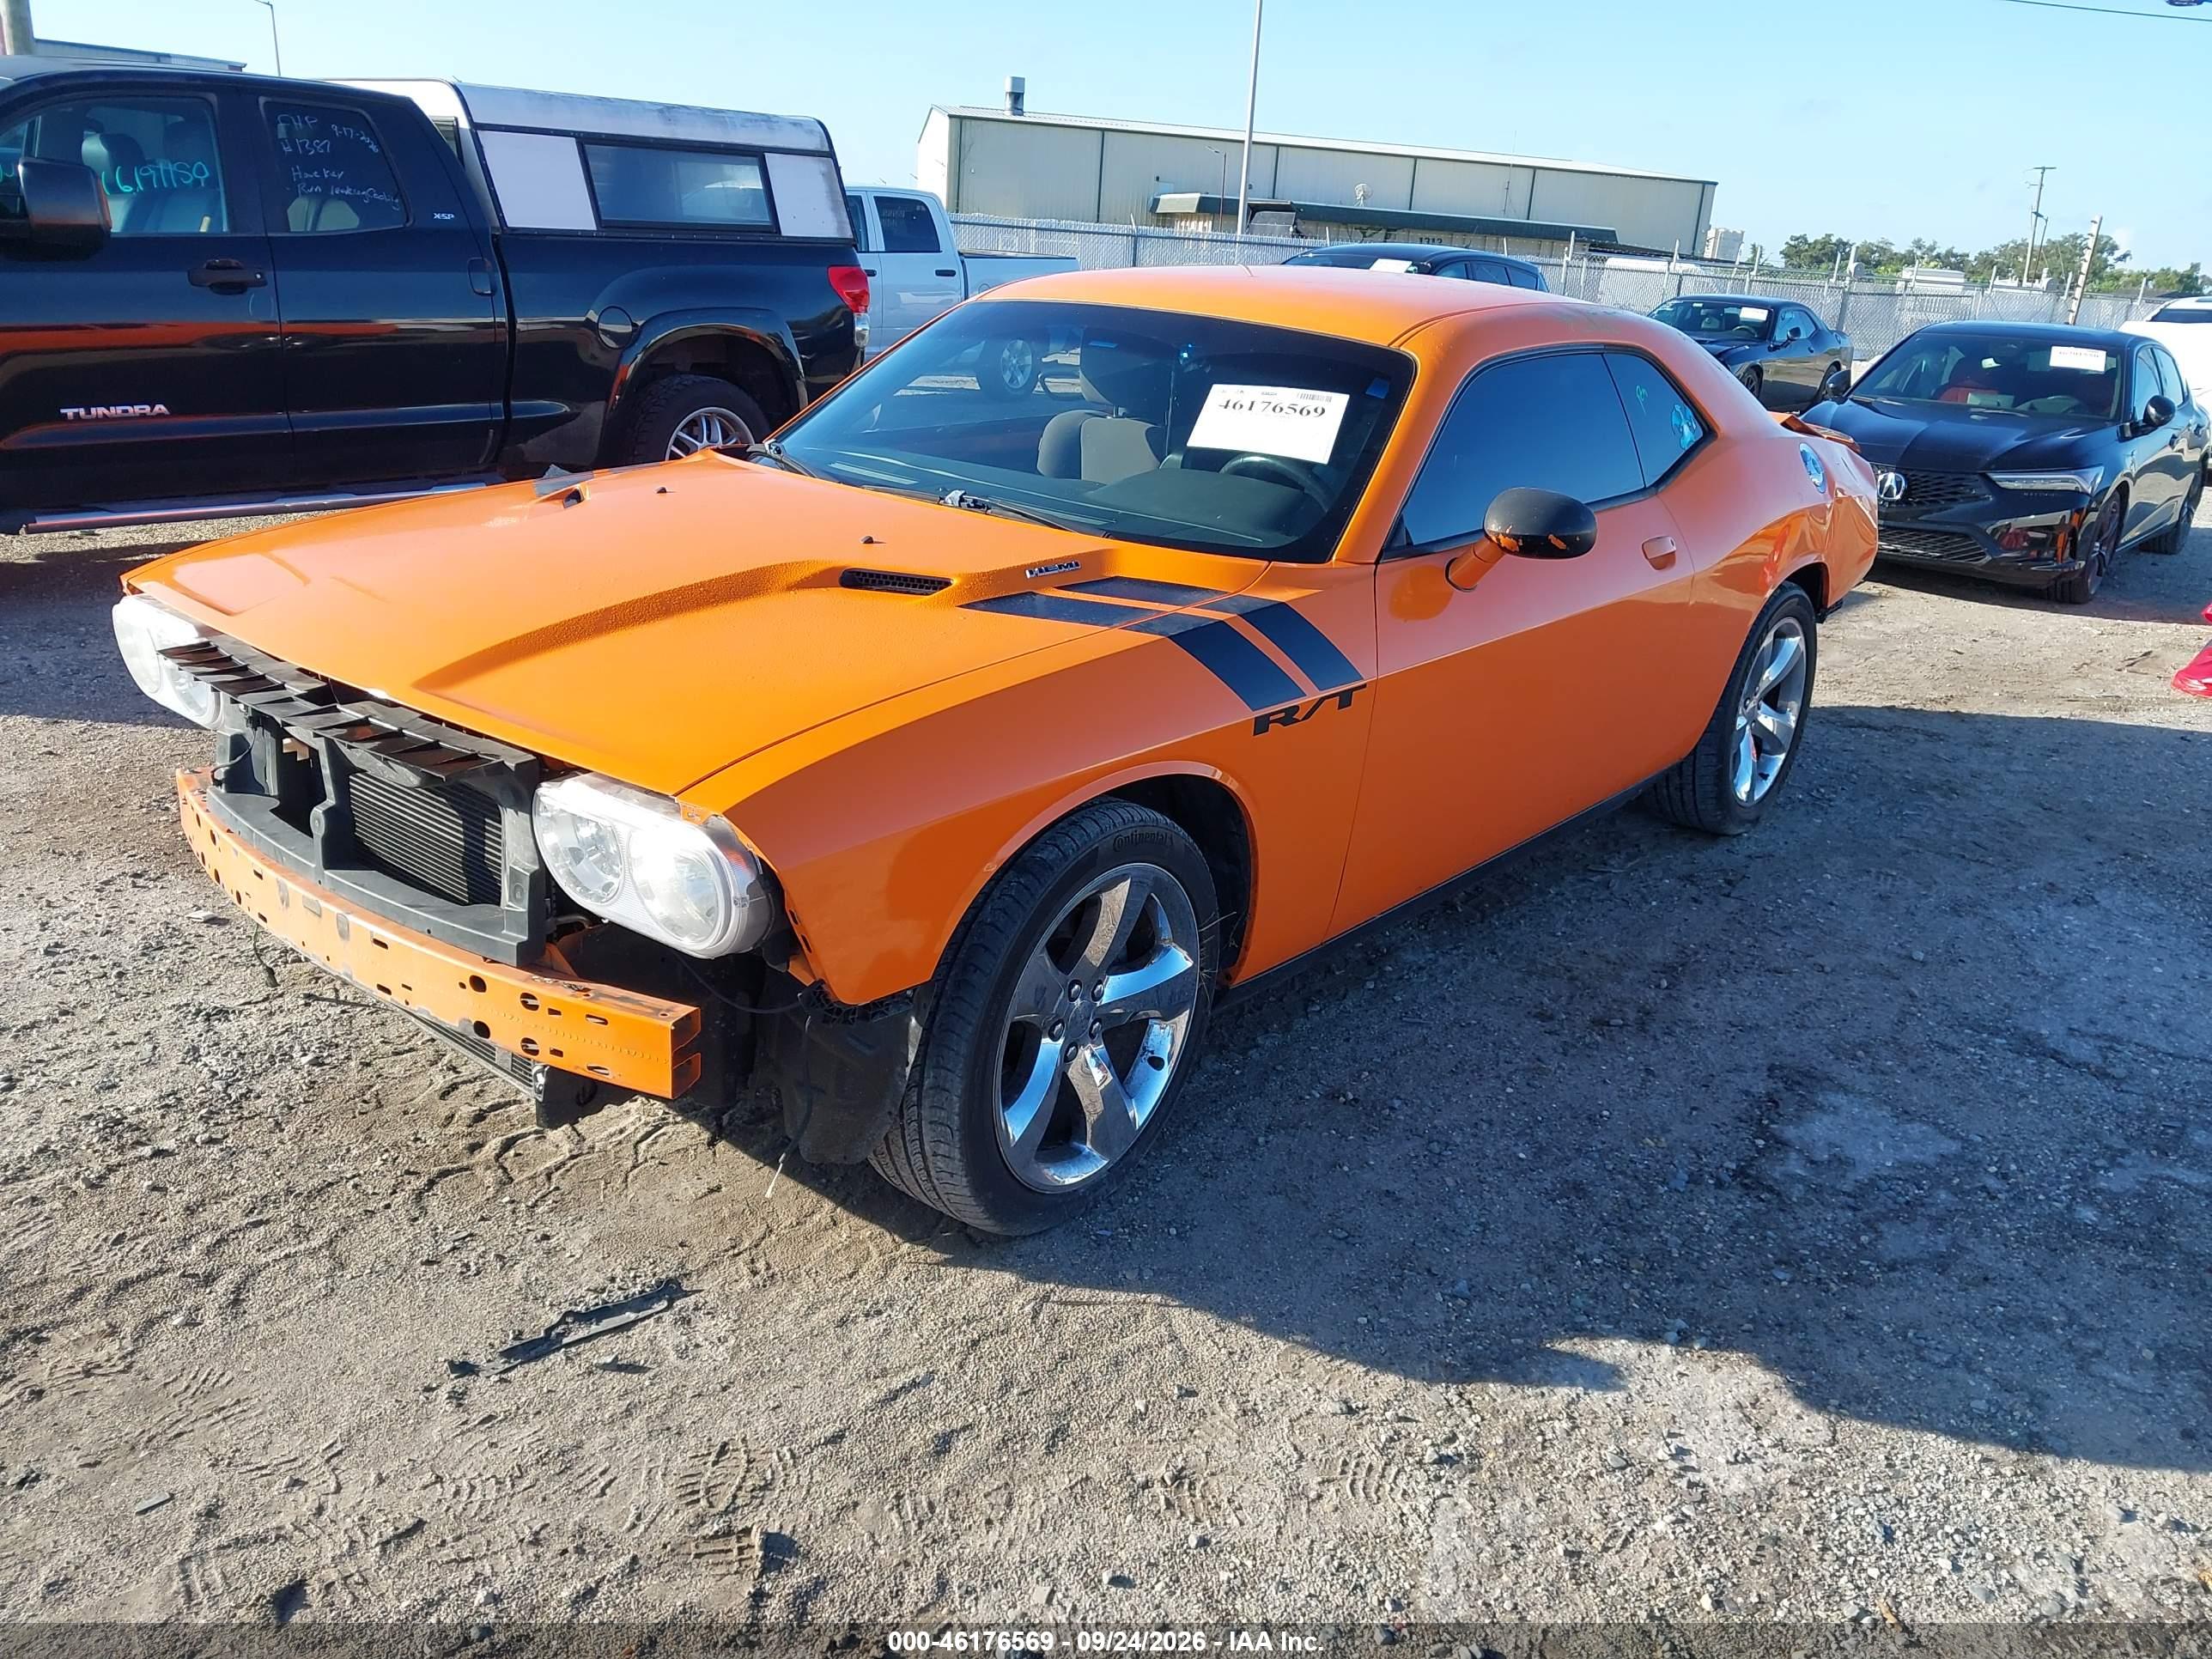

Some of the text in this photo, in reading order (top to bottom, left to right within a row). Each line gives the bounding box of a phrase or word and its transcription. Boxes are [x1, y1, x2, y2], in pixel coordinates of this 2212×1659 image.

[60, 404, 170, 420] TUNDRA
[1218, 398, 1326, 418] 46176569
[1024, 560, 1081, 579] HEMI
[1253, 684, 1367, 736] R/T
